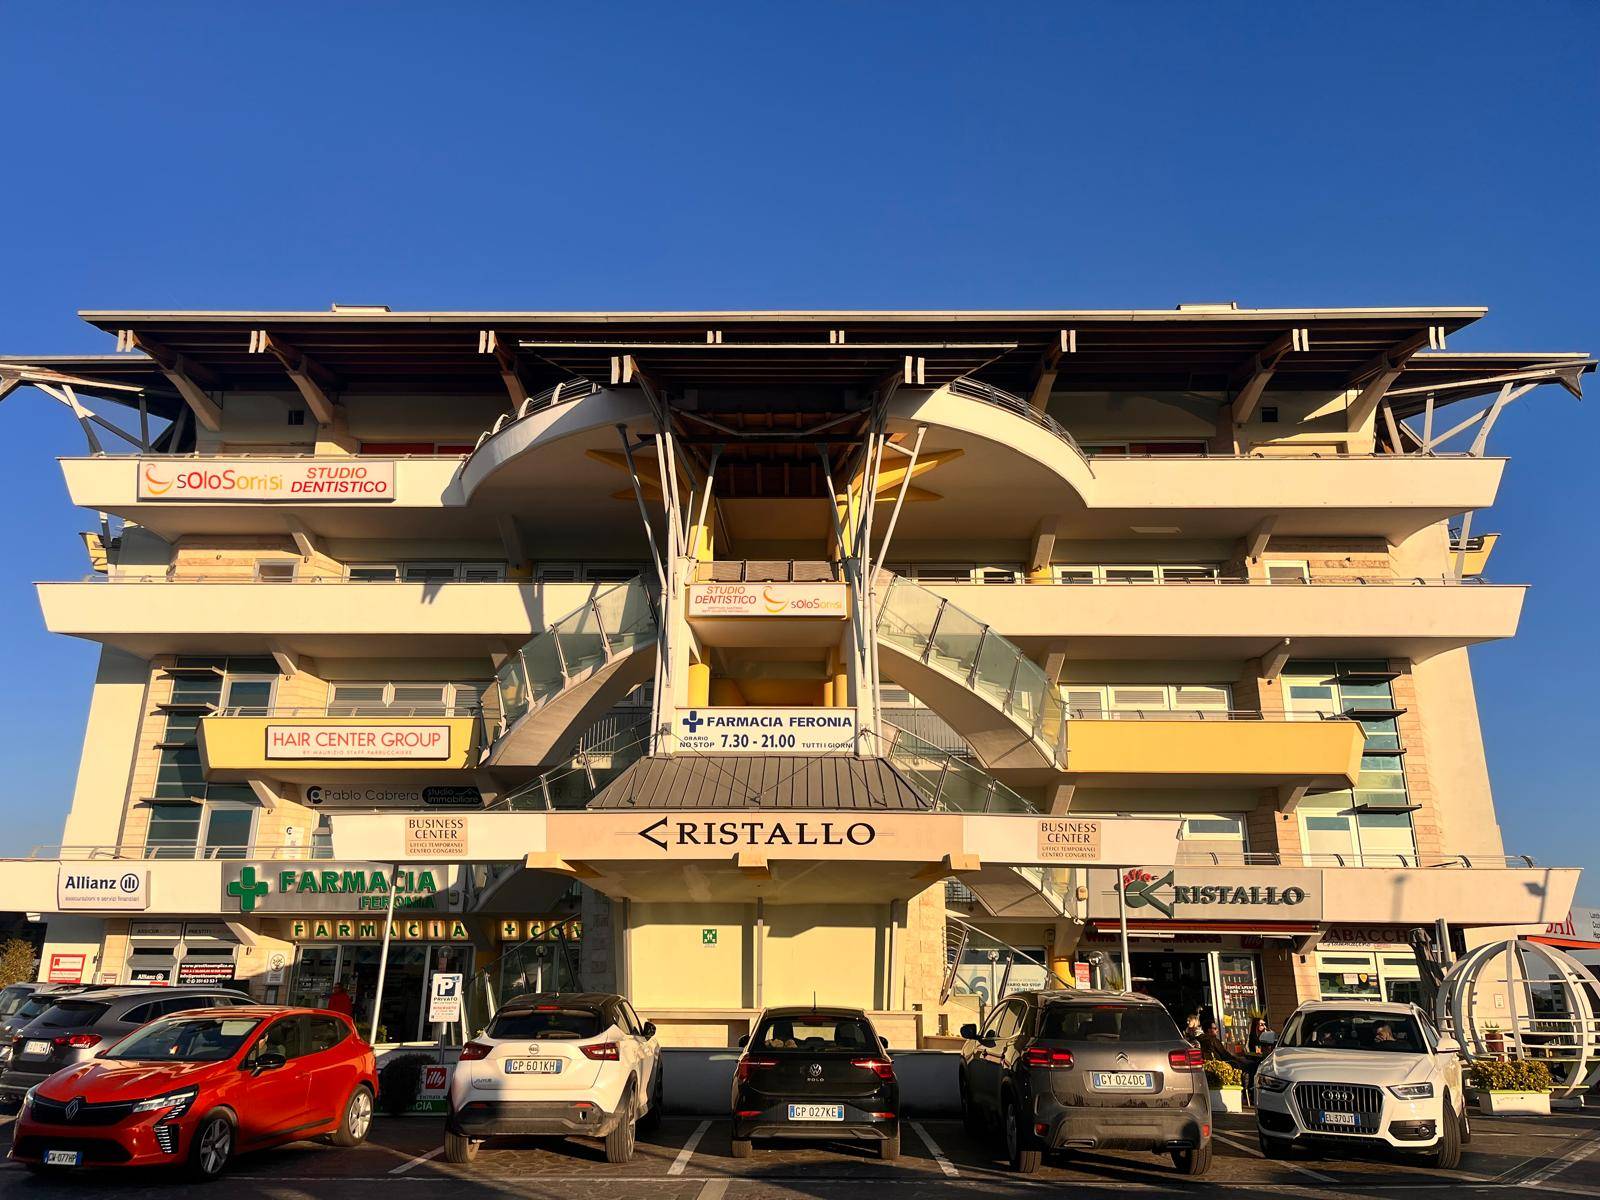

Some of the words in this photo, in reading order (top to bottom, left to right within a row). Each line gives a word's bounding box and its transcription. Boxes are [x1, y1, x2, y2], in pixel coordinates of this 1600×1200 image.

[306, 467, 368, 479] STUDIO
[290, 481, 387, 493] DENTISTICO
[707, 586, 746, 594] STUDIO
[695, 595, 757, 605] DENTISTICO
[707, 716, 783, 727] FARMACIA
[789, 716, 852, 727] FERONIA
[273, 732, 310, 747] HAIR
[316, 732, 376, 747] CENTER
[381, 732, 441, 747] GROUP
[721, 734, 749, 748] 7.30
[761, 734, 796, 748] 21.00
[324, 789, 361, 800] Pablo
[365, 789, 419, 800] Cabrera
[426, 788, 455, 796] studio
[409, 819, 464, 828] BUSINESS
[1041, 823, 1097, 832] BUSINESS
[415, 830, 457, 839] CENTER
[1047, 833, 1090, 843] CENTER
[65, 876, 117, 889] Allianz
[280, 871, 437, 893] FARMACIA
[360, 896, 435, 910] FERONIA
[294, 924, 465, 937] FARMACIA
[1323, 929, 1409, 942] ABACCH
[512, 1060, 525, 1071] GP
[526, 1060, 556, 1071] 601KH
[426, 1071, 445, 1087] illy
[1100, 1075, 1112, 1085] GY
[1115, 1075, 1145, 1086] 024DC
[795, 1107, 807, 1117] GP
[809, 1107, 836, 1117] 027KE
[1325, 1114, 1333, 1122] EL
